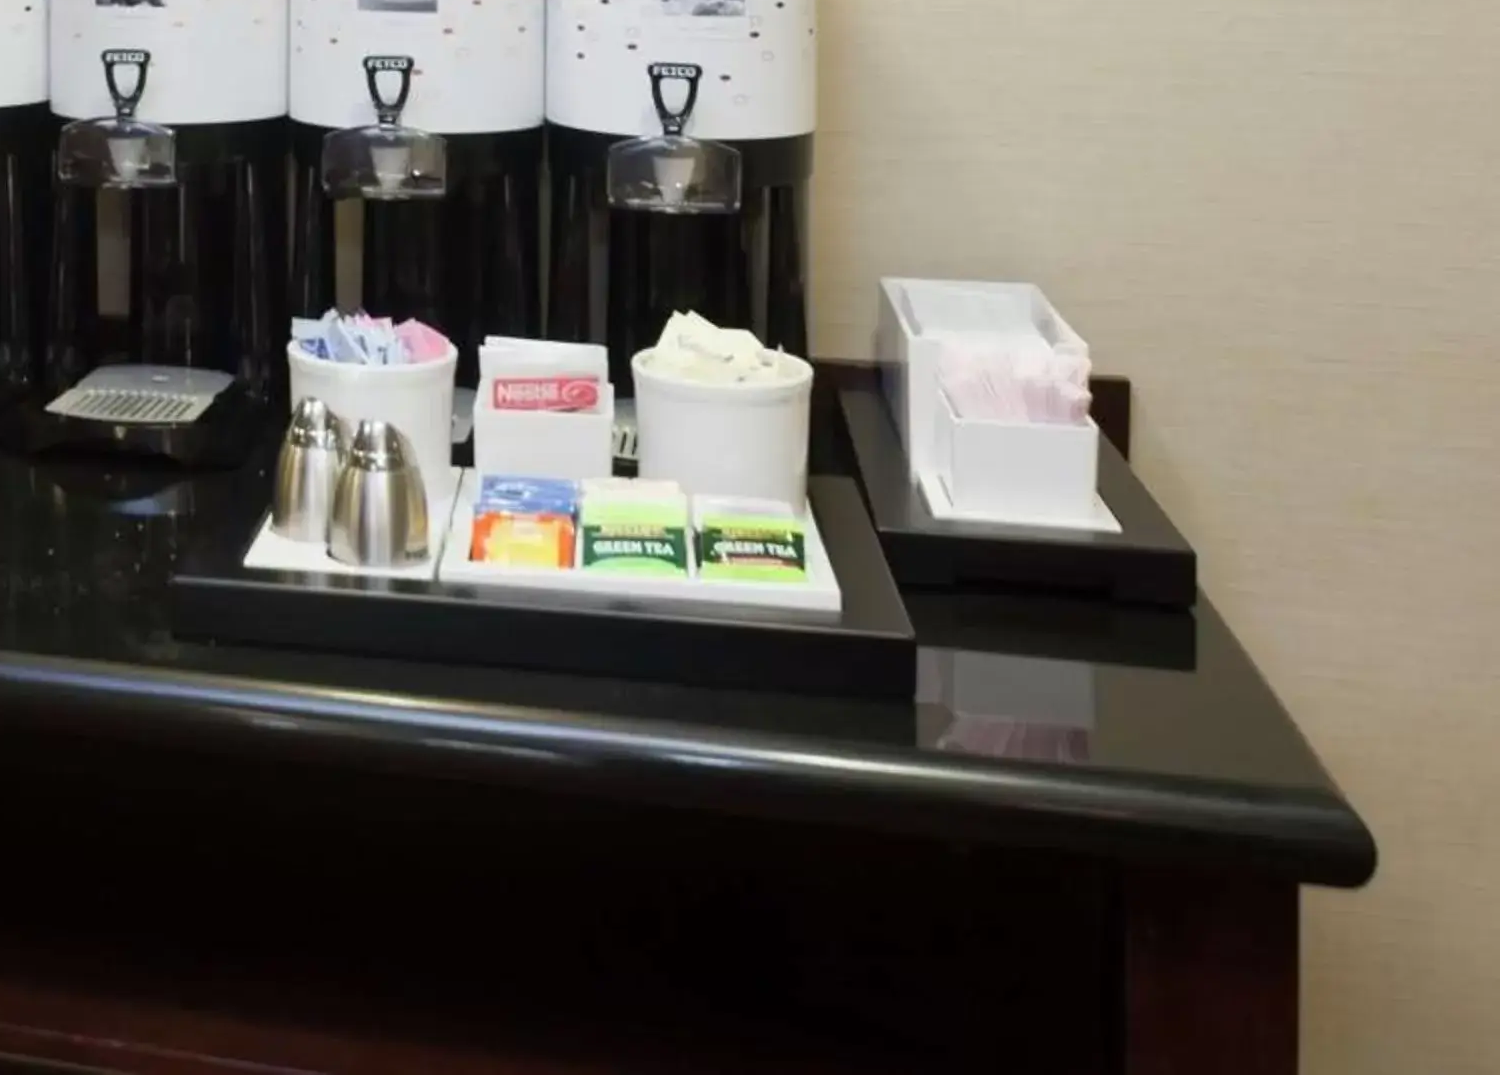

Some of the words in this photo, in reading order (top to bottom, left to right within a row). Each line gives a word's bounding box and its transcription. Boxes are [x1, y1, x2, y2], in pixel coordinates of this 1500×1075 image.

[592, 540, 643, 555] GREEN
[644, 540, 675, 557] TEA
[766, 541, 798, 558] TEA
